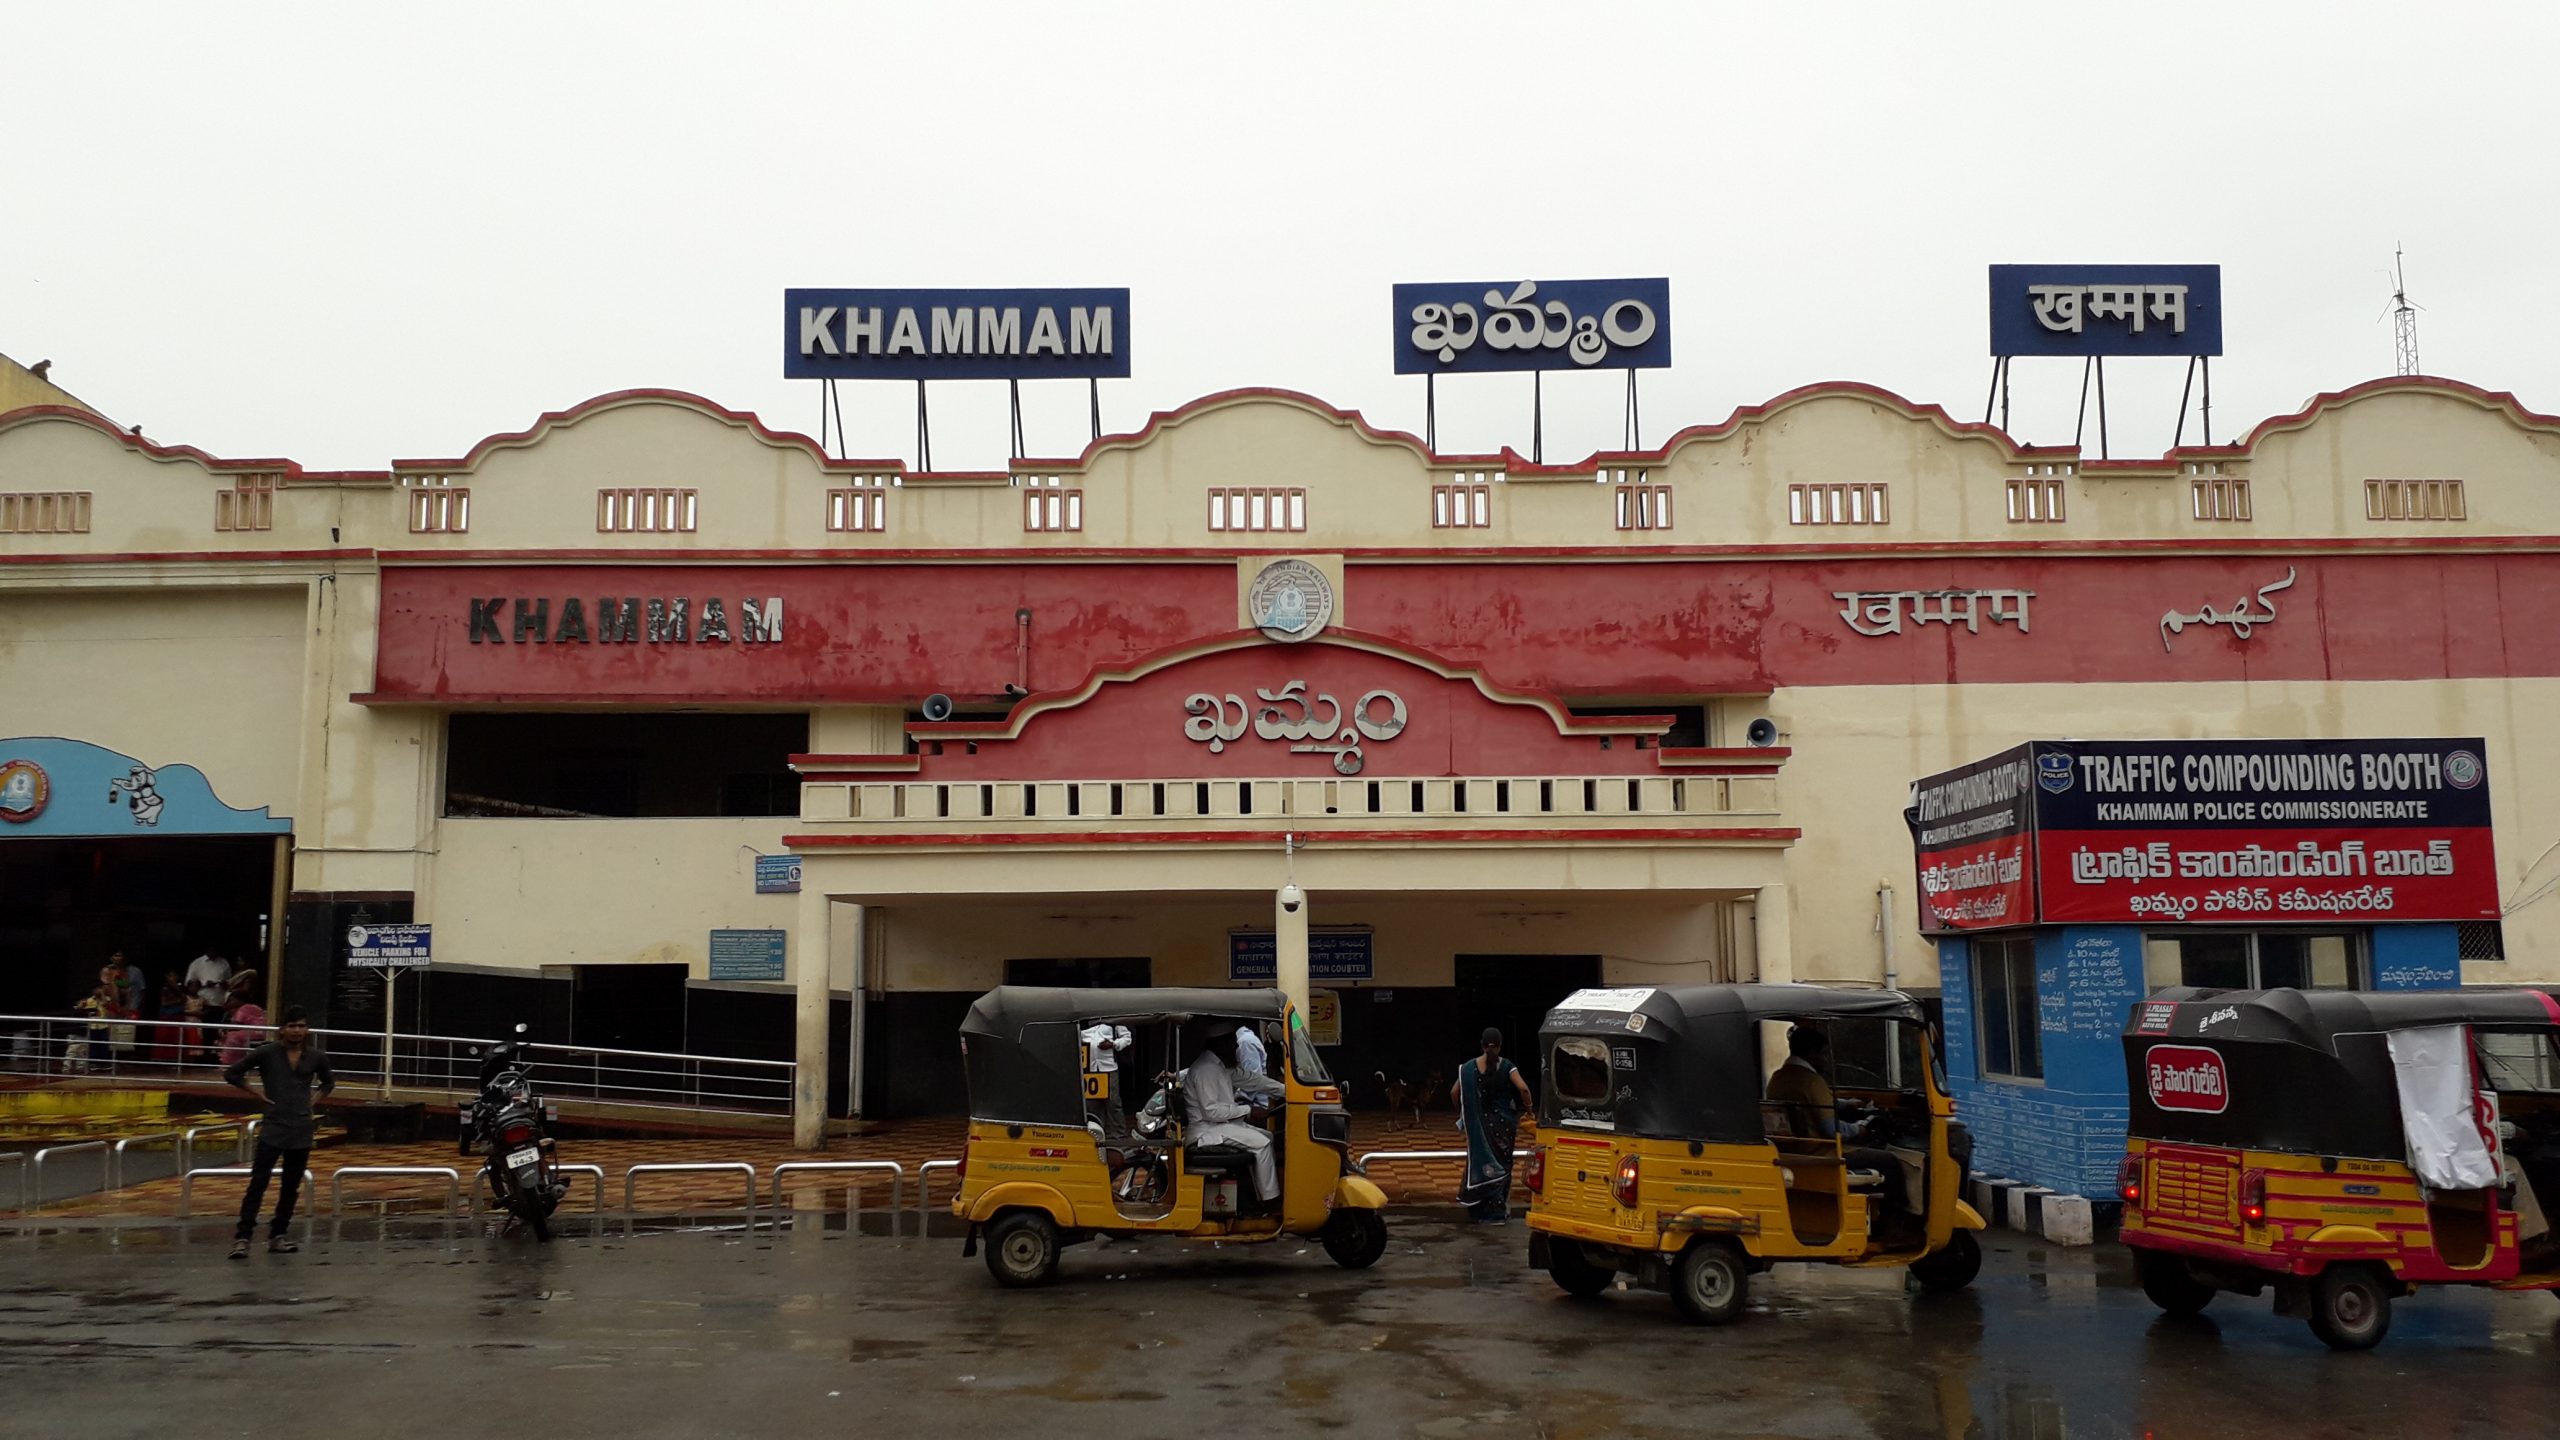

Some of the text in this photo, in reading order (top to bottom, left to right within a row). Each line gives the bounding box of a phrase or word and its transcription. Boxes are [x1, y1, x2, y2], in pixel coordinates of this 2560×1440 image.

[1411, 279, 1656, 365] ఖమ్మం
[2027, 284, 2188, 334] खम्मम
[800, 306, 1114, 357] KHAMMAM
[1276, 564, 1329, 609] INDIAN RAILWAYS
[469, 597, 784, 643] KHAMMAM
[1831, 588, 2037, 635] खम्मम
[1184, 680, 1408, 775] ఖమ్మం
[1993, 762, 2018, 802] BOOTH
[2042, 771, 2069, 779] POLICE
[2079, 754, 2176, 793] TRAFFIC
[2183, 753, 2355, 792] COMPOUNDING
[2363, 753, 2442, 791] BOOTH
[2097, 801, 2428, 821] KHAMMAM POLICE COMMISSIONERATE
[2071, 842, 2172, 884] ట్రాఫిక్
[2374, 840, 2455, 877] బూత్
[2130, 891, 2198, 921] ఖమ్మం
[2205, 887, 2274, 913] పోలీస్
[348, 957, 430, 967] PHYSICALLY CHALLENGED
[352, 947, 427, 957] VEHICLE PARKING FOR
[2077, 950, 2088, 958] 10
[2082, 959, 2086, 968] 1
[1236, 965, 1270, 974] GENERAL
[2080, 979, 2089, 987] 6
[2081, 969, 2089, 977] 2
[2094, 1019, 2102, 1029] 2
[2096, 1030, 2102, 1039] 6
